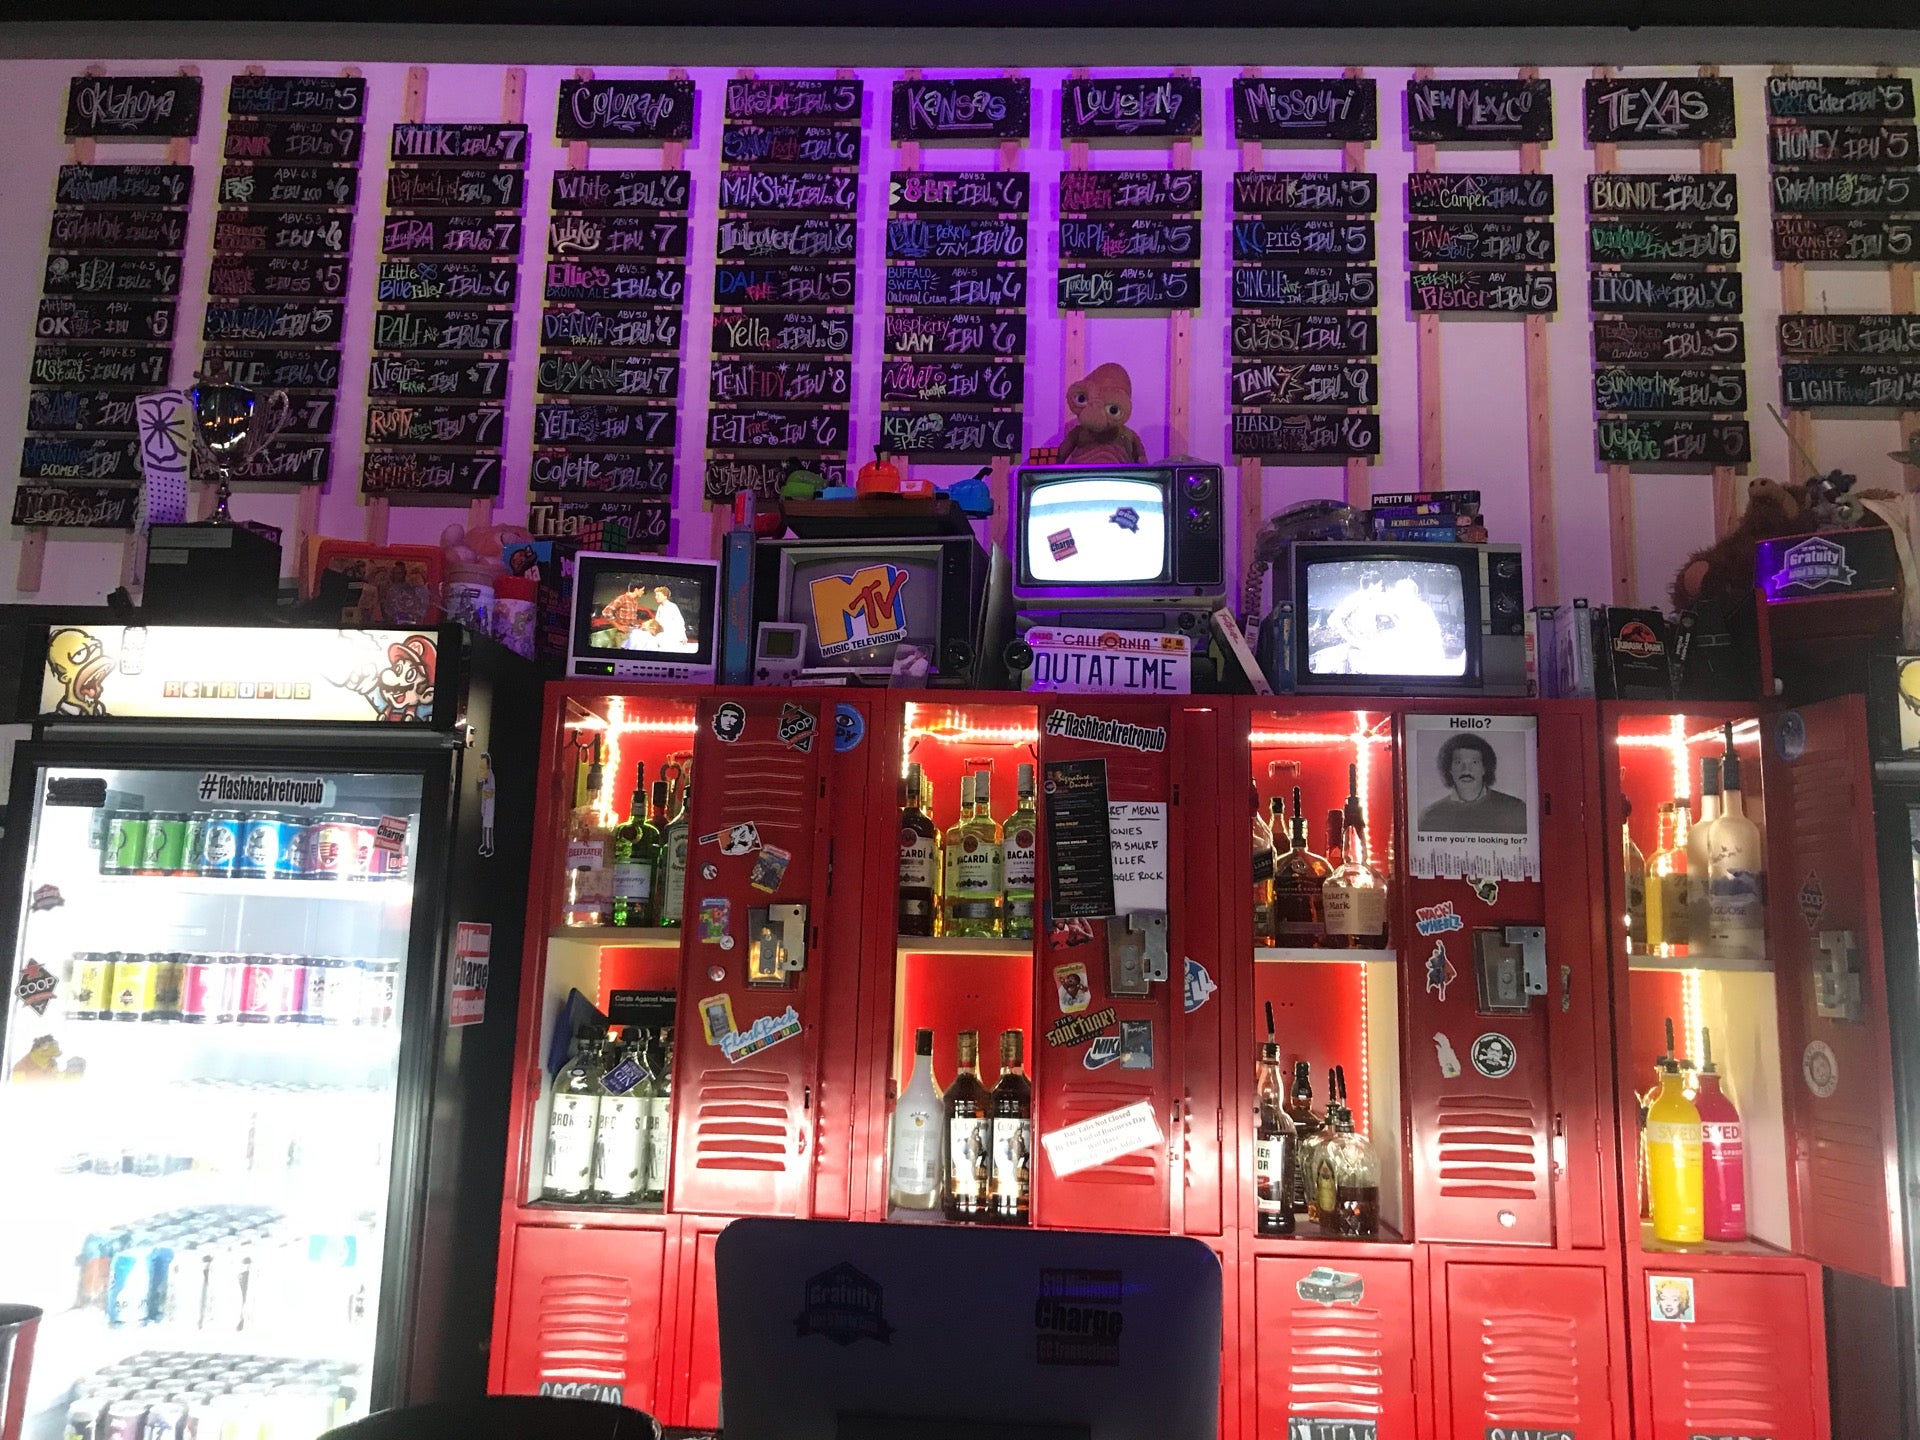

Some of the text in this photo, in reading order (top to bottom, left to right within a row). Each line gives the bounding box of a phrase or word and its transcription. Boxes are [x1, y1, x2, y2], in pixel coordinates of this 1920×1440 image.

[1770, 78, 1826, 97] Original
[1598, 81, 1709, 132] TEXAS
[1807, 93, 1846, 114] Cider
[394, 130, 455, 155] MILK
[1777, 128, 1838, 161] HONEY
[558, 175, 611, 199] White
[1593, 181, 1665, 210] BLONDE
[1440, 190, 1488, 211] Camper
[1266, 231, 1302, 247] PILS
[1412, 225, 1452, 252] JAVA
[382, 265, 419, 280] Little
[888, 268, 931, 278] BUFFALO
[888, 279, 930, 290] SWEAT
[1419, 286, 1491, 310] Pilsner
[39, 317, 70, 334] OK
[725, 318, 770, 348] Yella
[886, 315, 950, 338] Raspberry
[896, 325, 984, 353] JAM IBU
[948, 370, 979, 396] IBU
[1233, 365, 1280, 393] TANK
[1788, 379, 1846, 402] LIGHT
[884, 417, 915, 436] KEY
[1235, 415, 1282, 432] HARD
[901, 435, 928, 450] PIE
[1623, 440, 1661, 461] PUG
[40, 464, 80, 477] BOOMER
[1374, 494, 1413, 504] PRETTY IN
[1790, 550, 1839, 565] Gratuity
[811, 563, 909, 647] MTV
[822, 631, 903, 657] MUSIC TELEVISION
[1062, 634, 1151, 650] CALIFORNIA
[1617, 639, 1644, 651] JURASSIC
[1644, 641, 1663, 652] PARK
[1034, 652, 1178, 691] OUTATIME
[163, 681, 311, 699] RETROPUB
[781, 718, 814, 739] COOP
[1048, 711, 1164, 750] #flashbackretropub
[1450, 717, 1492, 730] Hello?
[200, 775, 324, 804] #flashbackretropub
[1132, 806, 1159, 816] MENU
[377, 825, 405, 842] Charge
[1417, 834, 1425, 842] Is
[1427, 834, 1433, 842] it
[1449, 835, 1476, 845] you're
[1477, 835, 1509, 846] looking
[1510, 836, 1527, 845] for?
[569, 847, 603, 857] BEEFEATER
[1125, 840, 1159, 851] SMURF
[1138, 871, 1164, 881] ROCK
[1329, 901, 1351, 910] Mark
[1418, 901, 1453, 922] WACKY
[453, 956, 489, 989] Charge
[18, 977, 55, 996] COOP
[636, 995, 658, 1003] Against
[1046, 1007, 1117, 1047] SANCTUARY
[1054, 1016, 1073, 1027] THE
[614, 1070, 632, 1087] GIN
[1095, 1119, 1108, 1127] Not
[1108, 1110, 1131, 1123] Closed
[1132, 1116, 1147, 1125] Day
[1035, 1298, 1124, 1337] Charge
